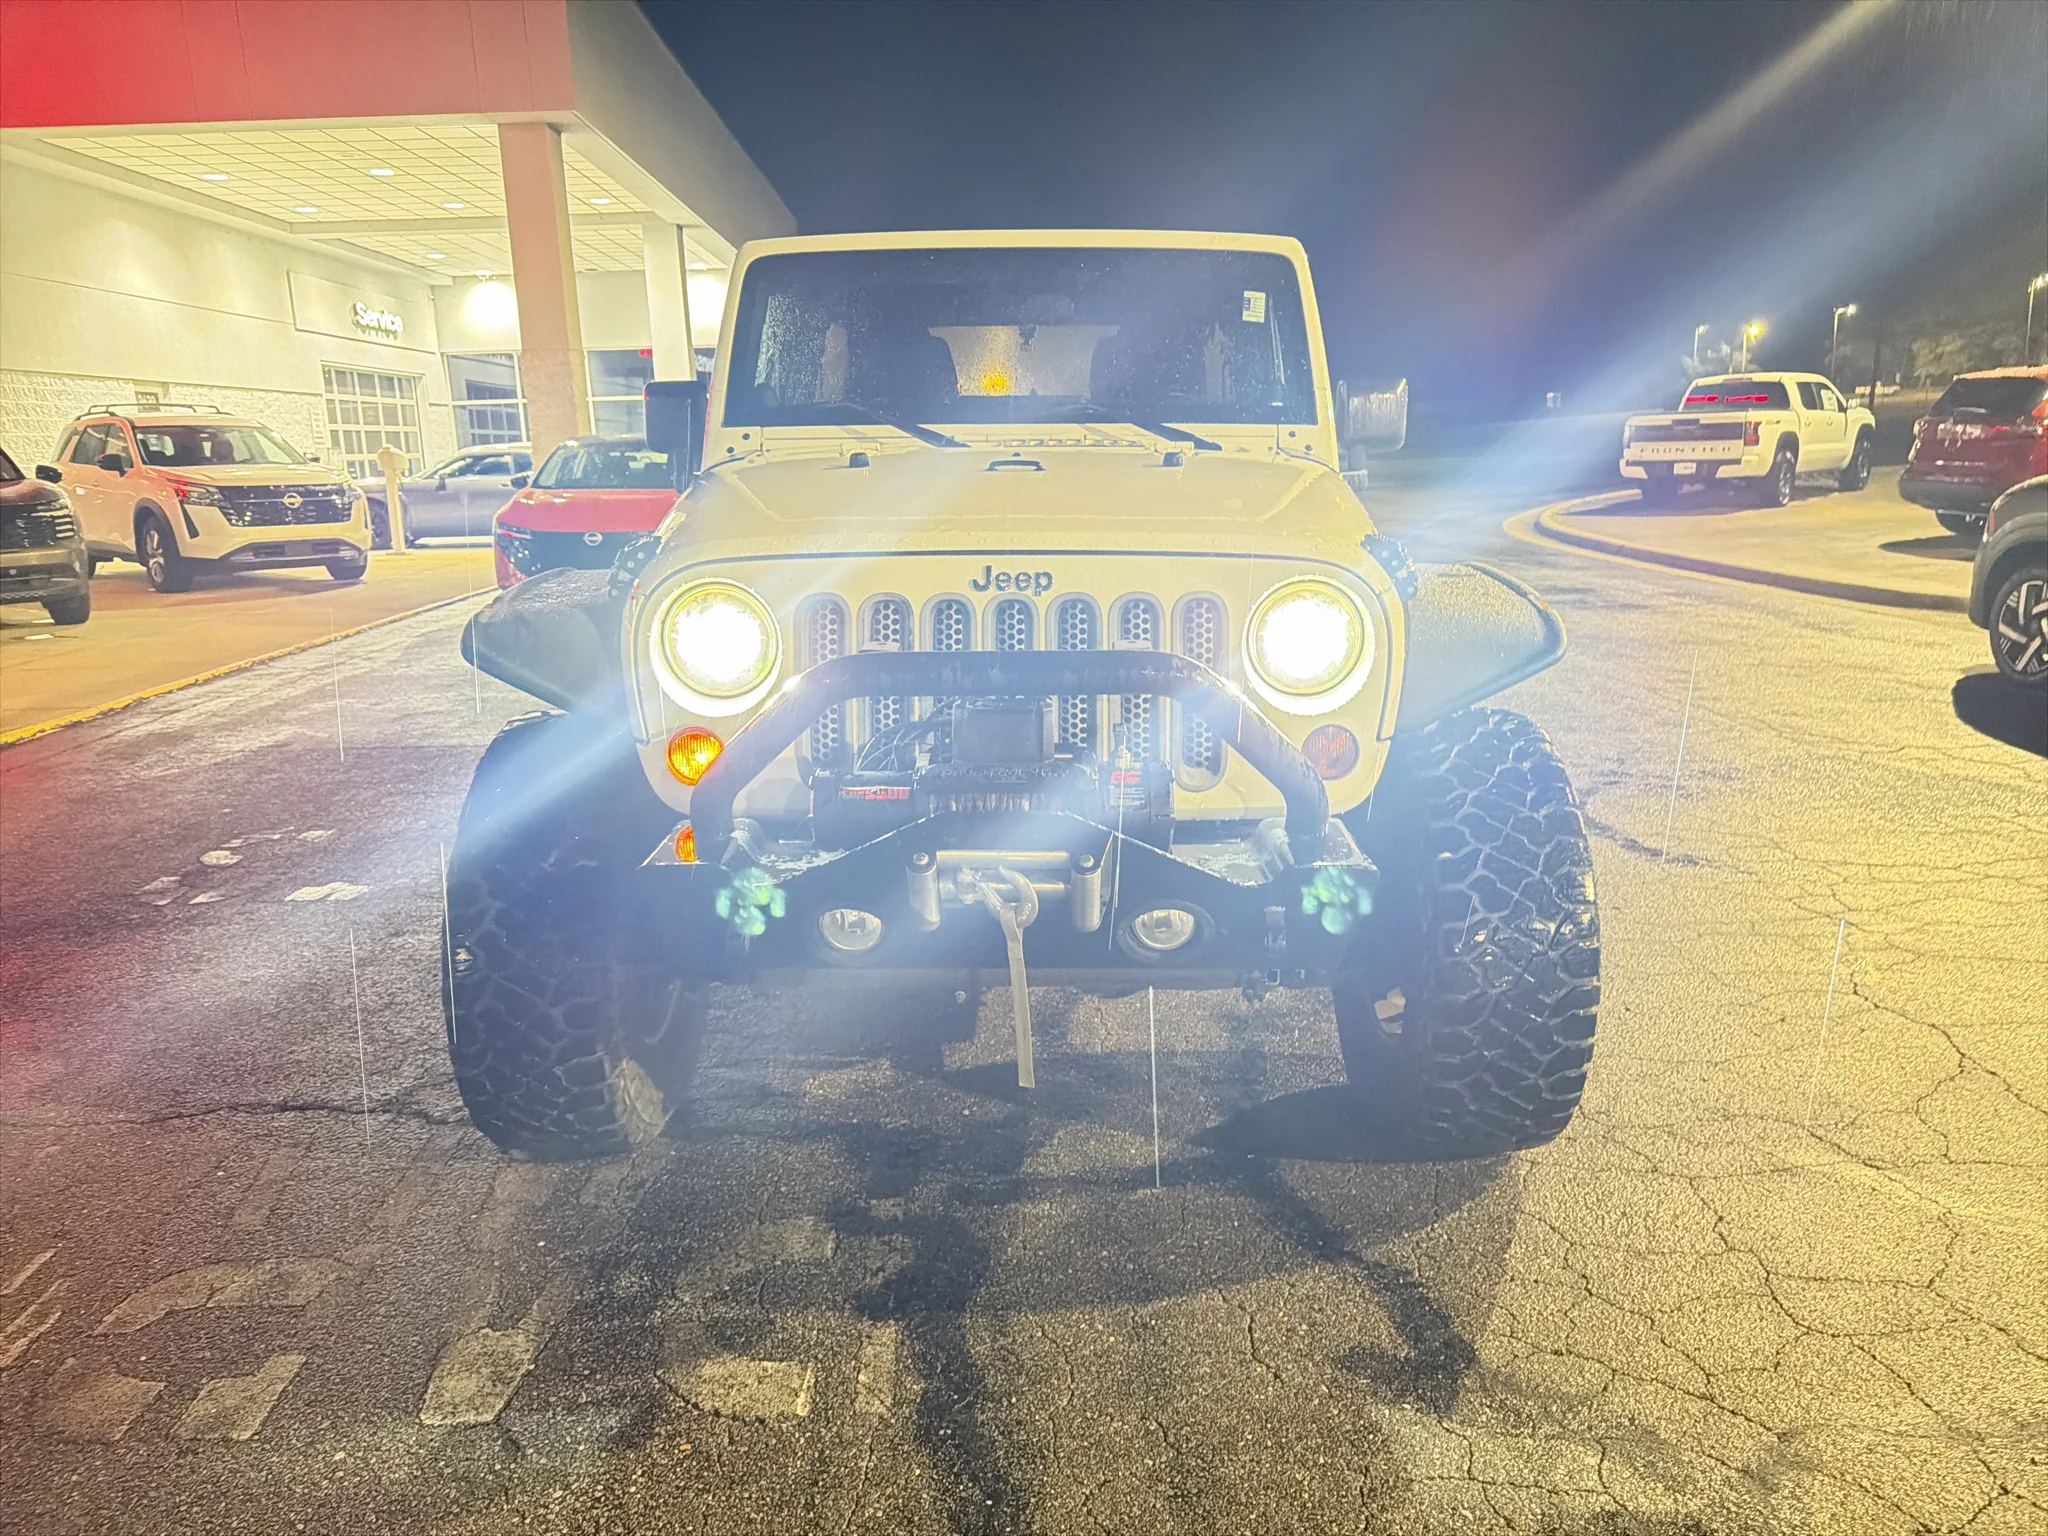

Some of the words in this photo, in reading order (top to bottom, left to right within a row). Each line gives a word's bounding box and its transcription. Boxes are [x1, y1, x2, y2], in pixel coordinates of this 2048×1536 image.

[354, 301, 404, 333] Service
[1640, 446, 1732, 454] FRONTIER
[969, 565, 1053, 597] Jeep
